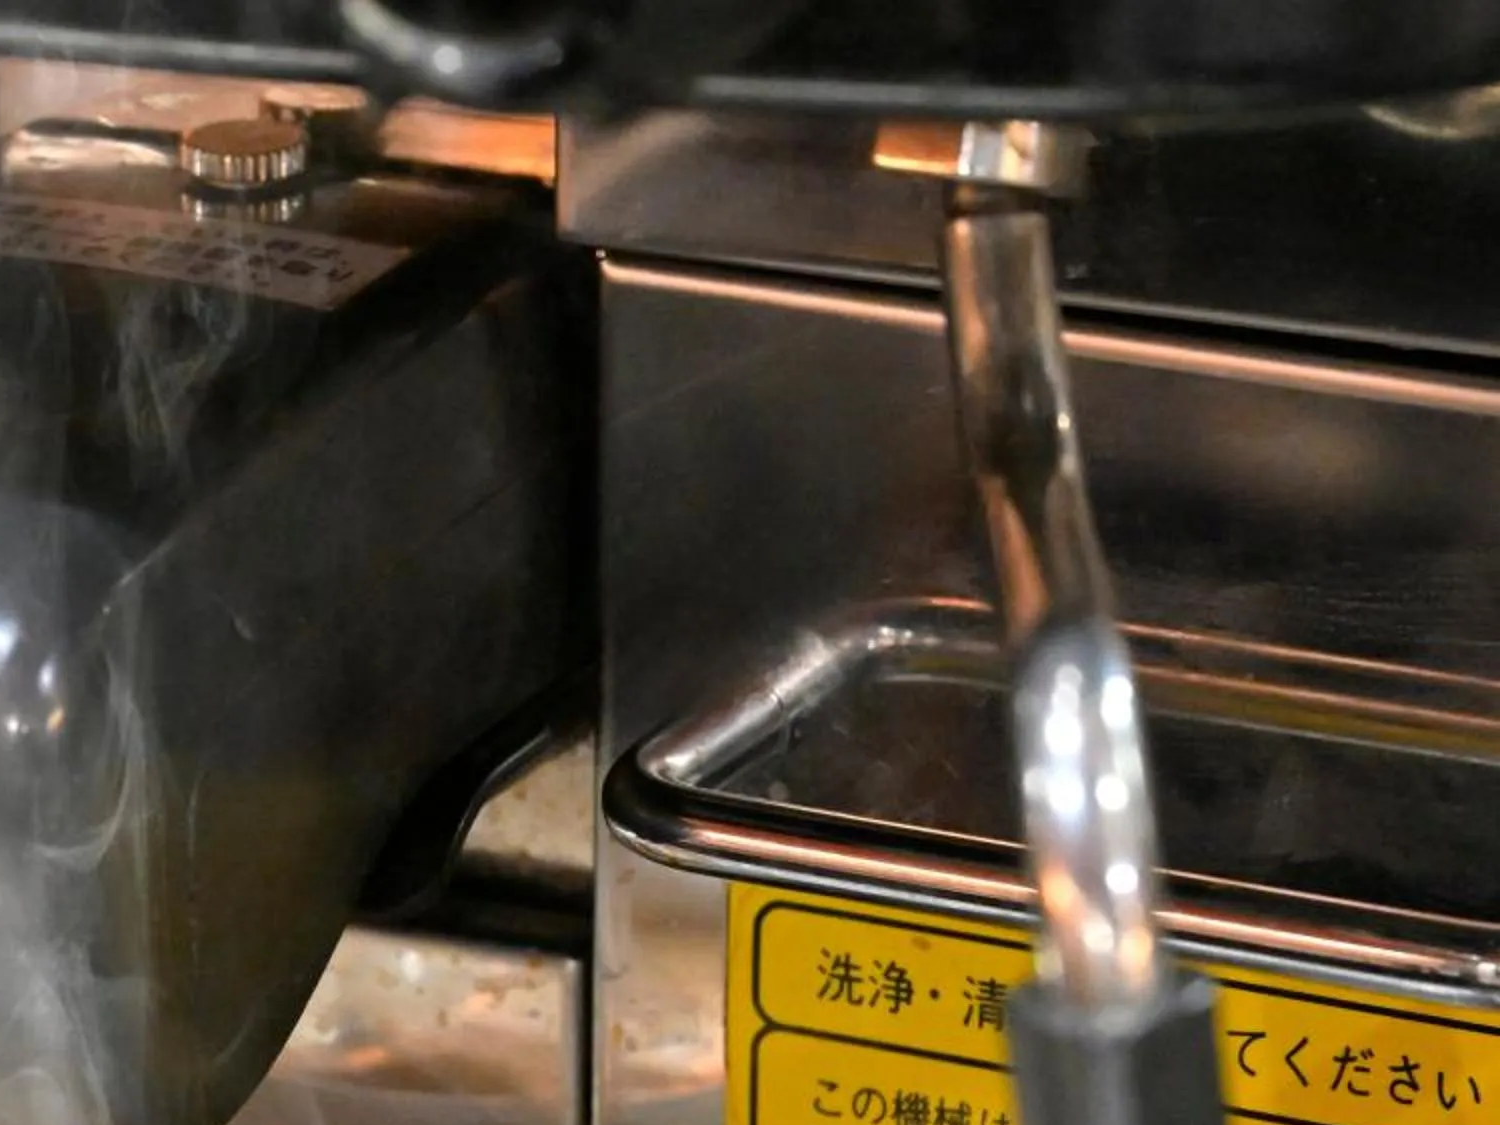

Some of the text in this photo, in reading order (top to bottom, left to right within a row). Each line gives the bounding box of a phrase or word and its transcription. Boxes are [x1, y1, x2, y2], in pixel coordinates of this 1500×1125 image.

[1227, 1029, 1481, 1110] てください
